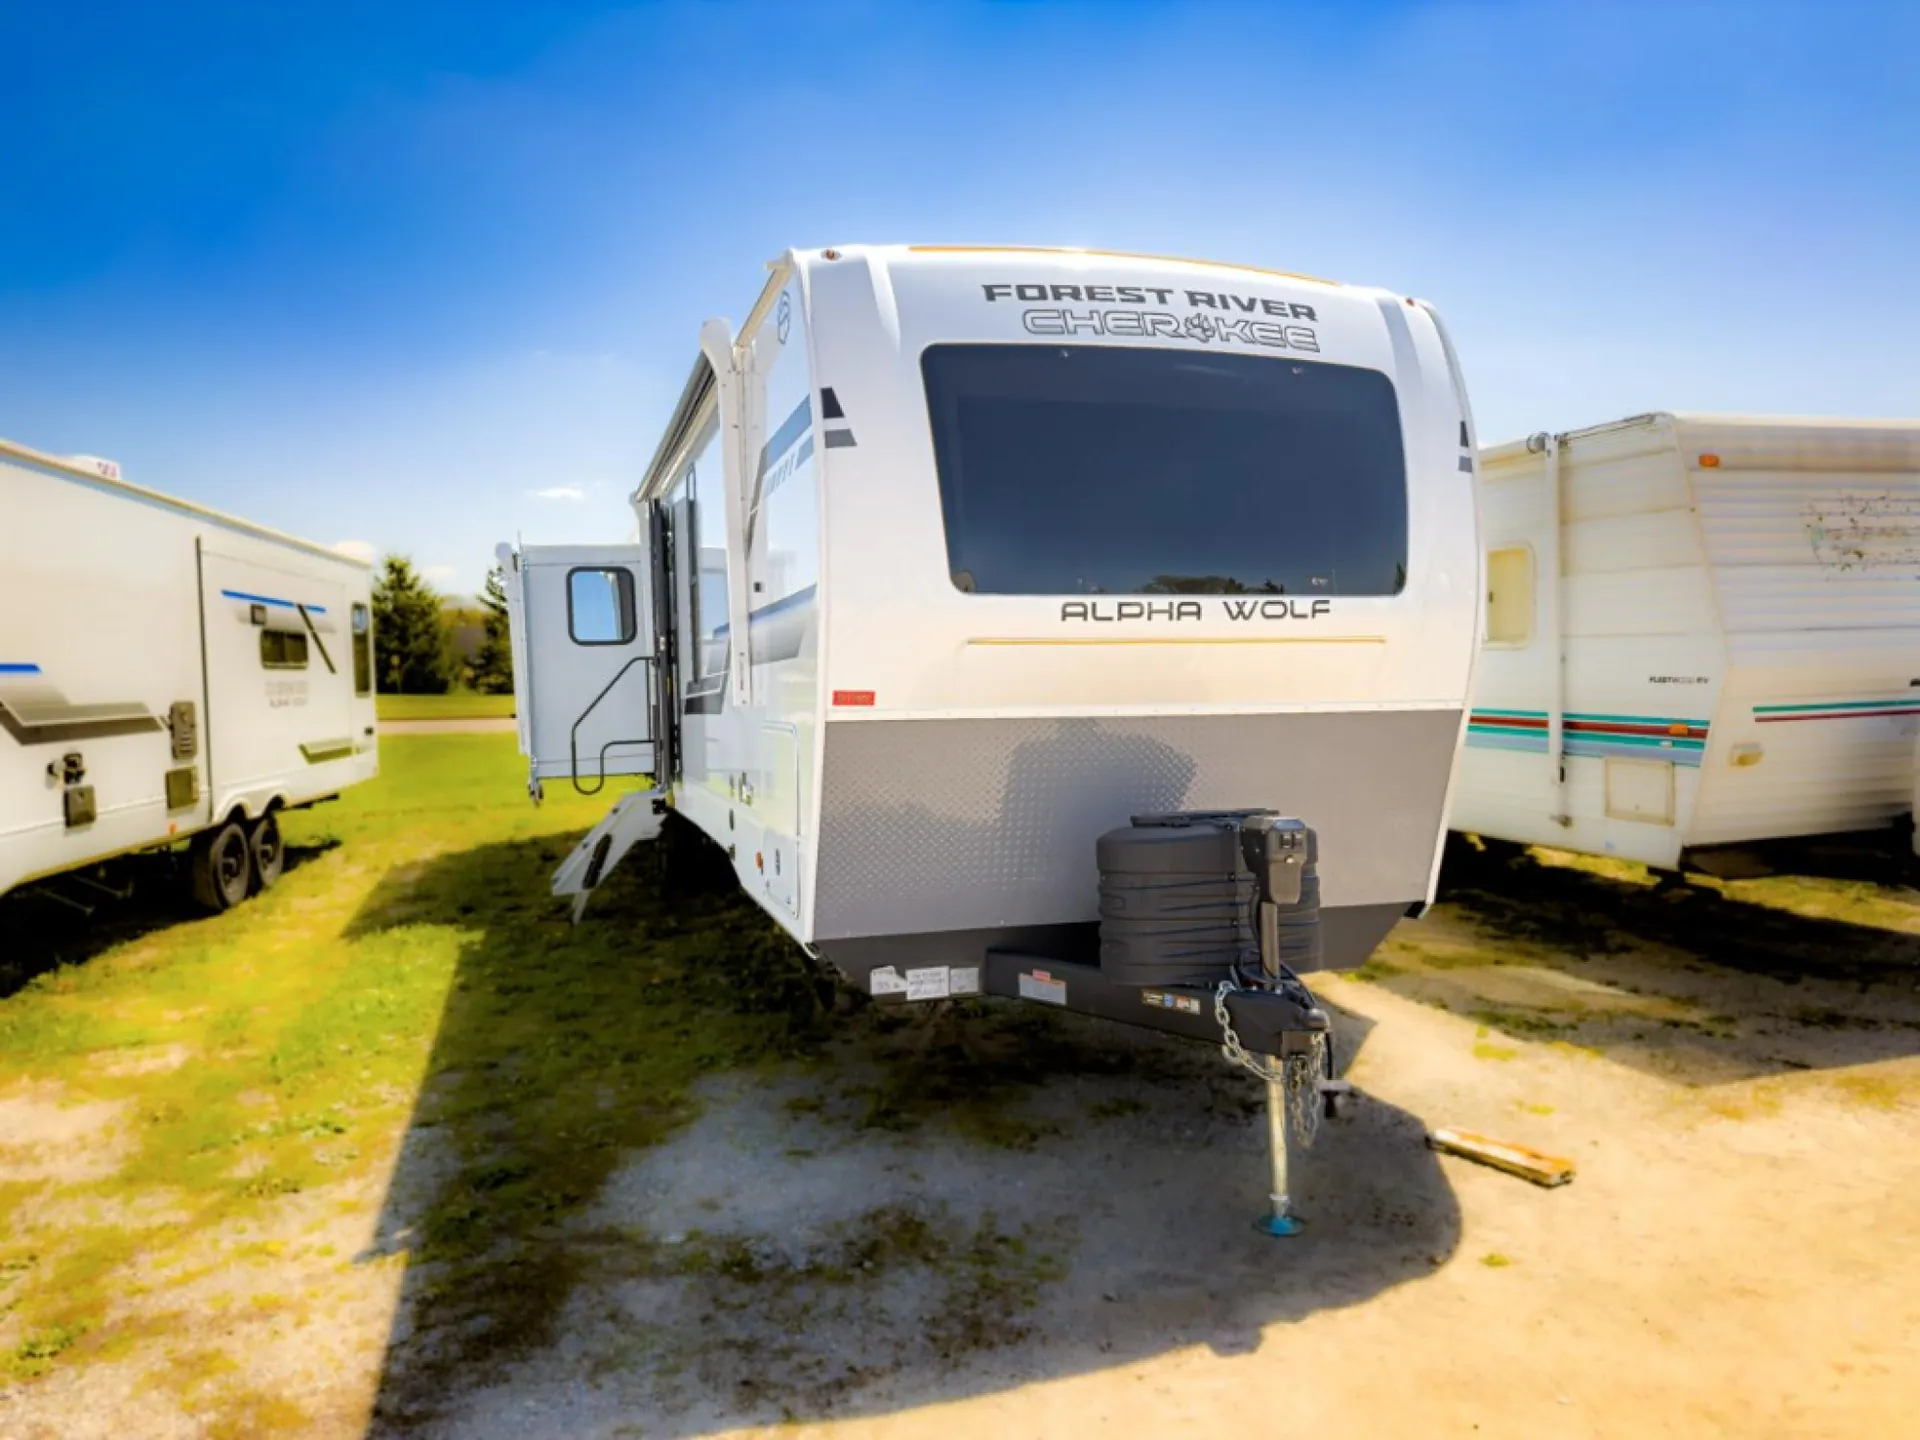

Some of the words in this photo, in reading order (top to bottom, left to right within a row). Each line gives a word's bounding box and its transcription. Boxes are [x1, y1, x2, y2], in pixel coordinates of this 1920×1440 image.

[982, 284, 1174, 305] FOREST
[1184, 289, 1318, 322] RIVER
[1022, 308, 1320, 353] CHEROKEE
[1061, 600, 1203, 622] ALPHA
[1223, 599, 1331, 621] WOLF
[1648, 676, 1695, 684] FLEETW
